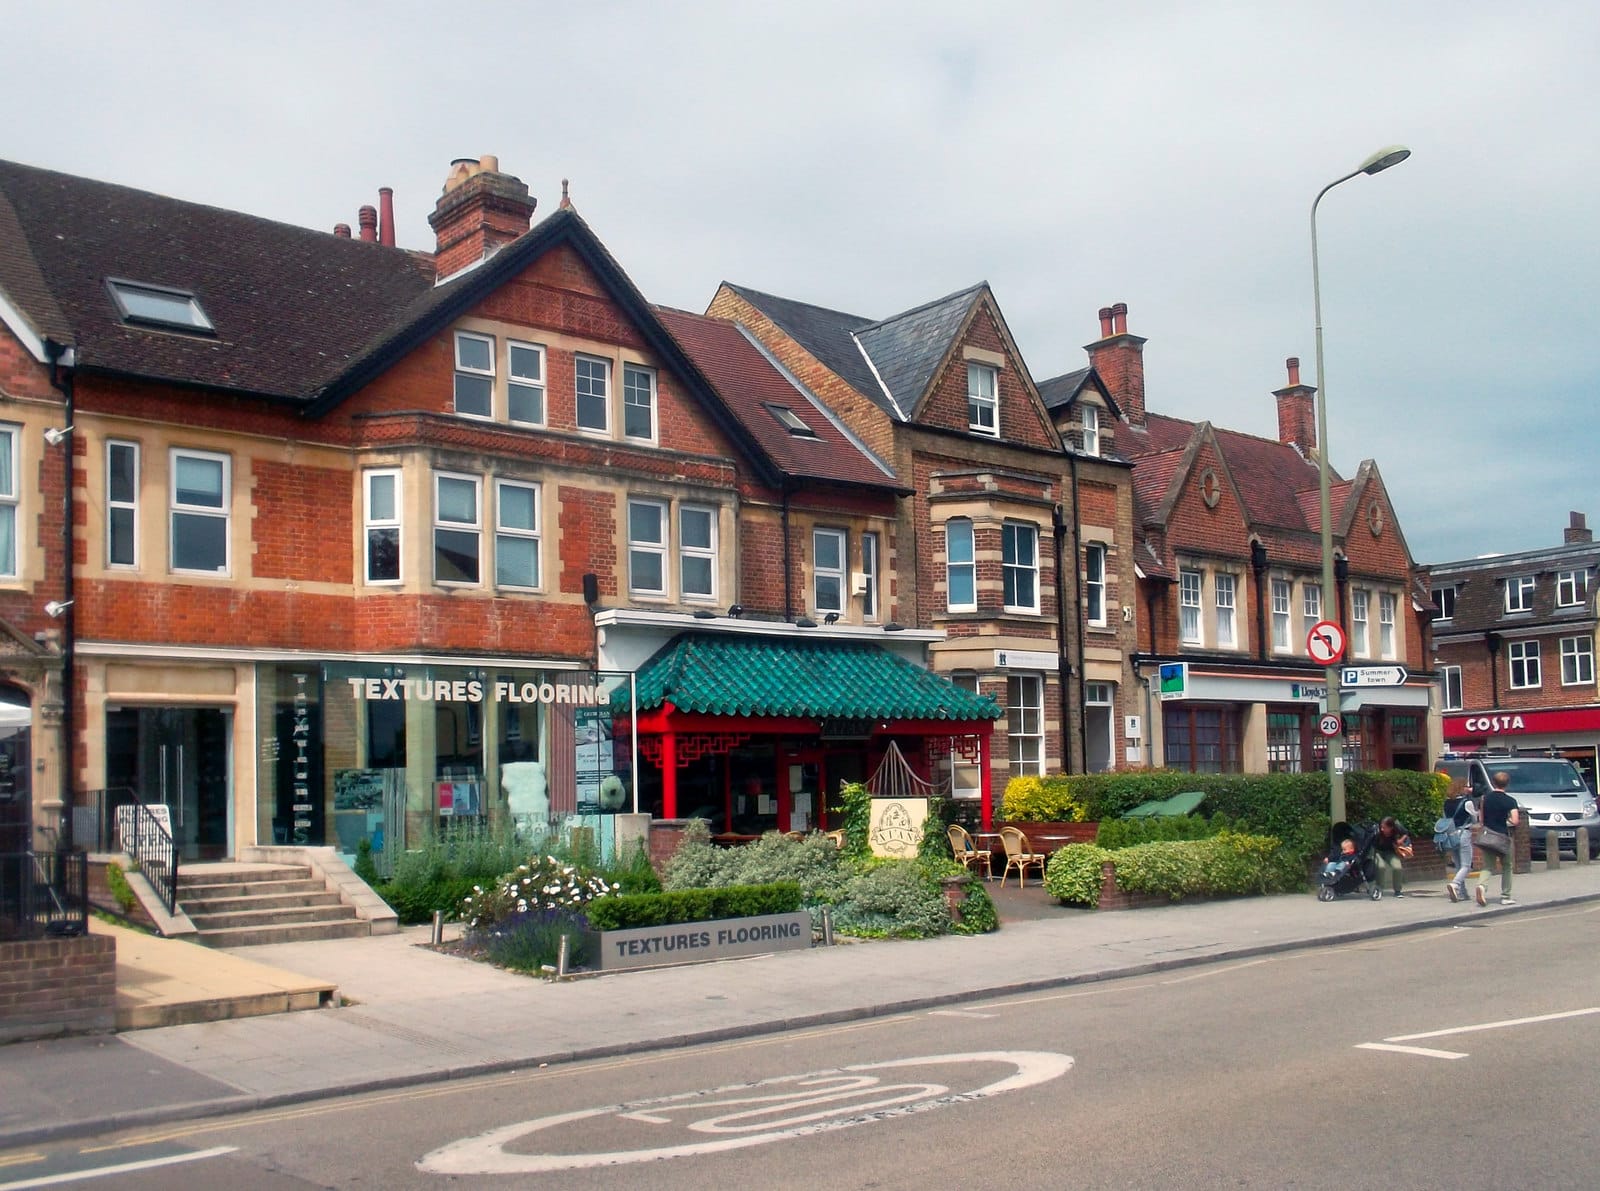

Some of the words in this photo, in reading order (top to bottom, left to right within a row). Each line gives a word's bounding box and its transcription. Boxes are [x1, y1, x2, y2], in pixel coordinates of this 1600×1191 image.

[348, 677, 483, 702] TEXTURES
[495, 681, 611, 705] FLOORING
[1301, 686, 1320, 699] Lloyds
[1322, 721, 1338, 730] 20
[1465, 715, 1525, 732] COSTA
[119, 807, 168, 815] TETURES
[615, 932, 711, 957] TEXTURES
[718, 922, 801, 945] FLOORING
